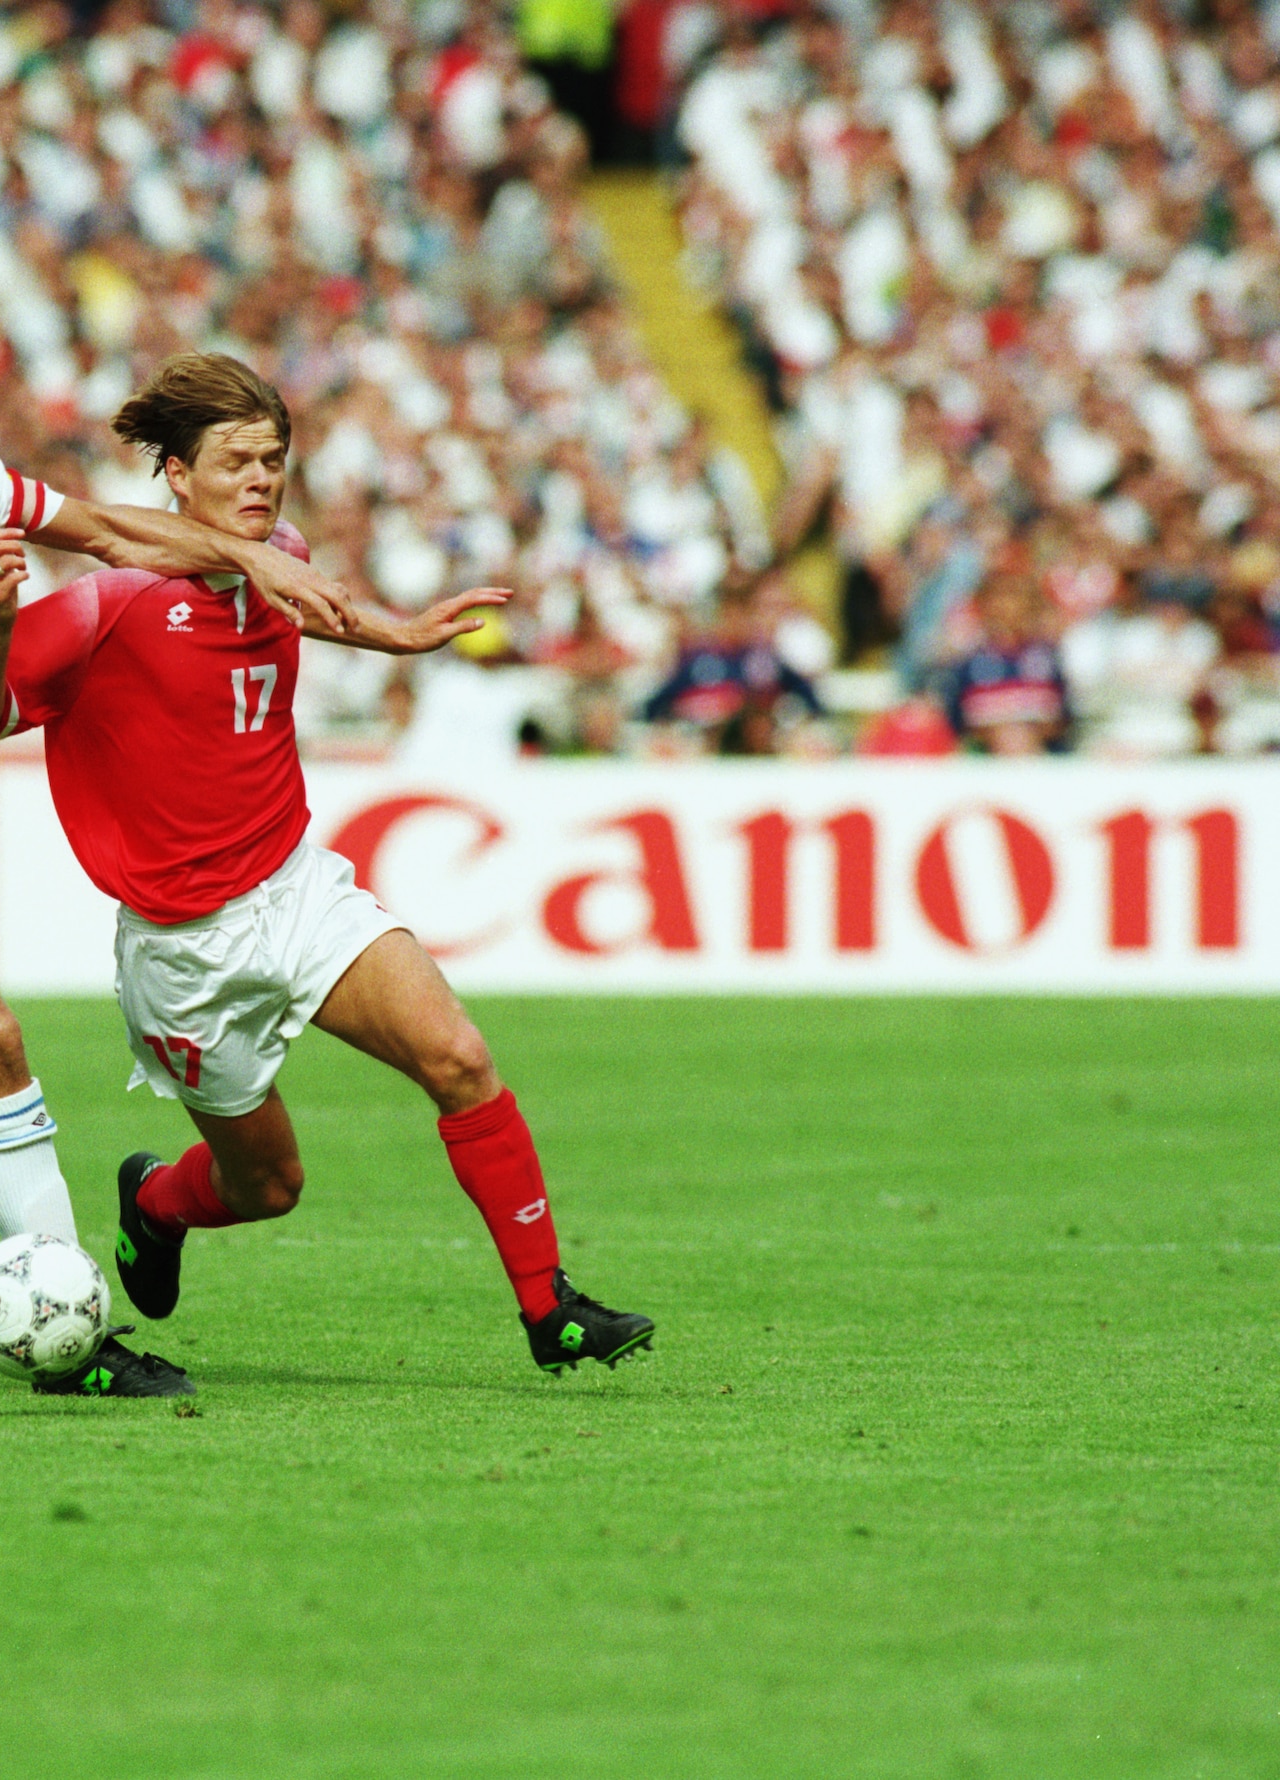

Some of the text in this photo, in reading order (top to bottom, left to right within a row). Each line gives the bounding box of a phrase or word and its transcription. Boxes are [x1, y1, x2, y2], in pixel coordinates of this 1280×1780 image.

[166, 624, 194, 632] lotto
[231, 663, 278, 734] 17
[325, 793, 1241, 957] Canon
[142, 1034, 203, 1089] 17
